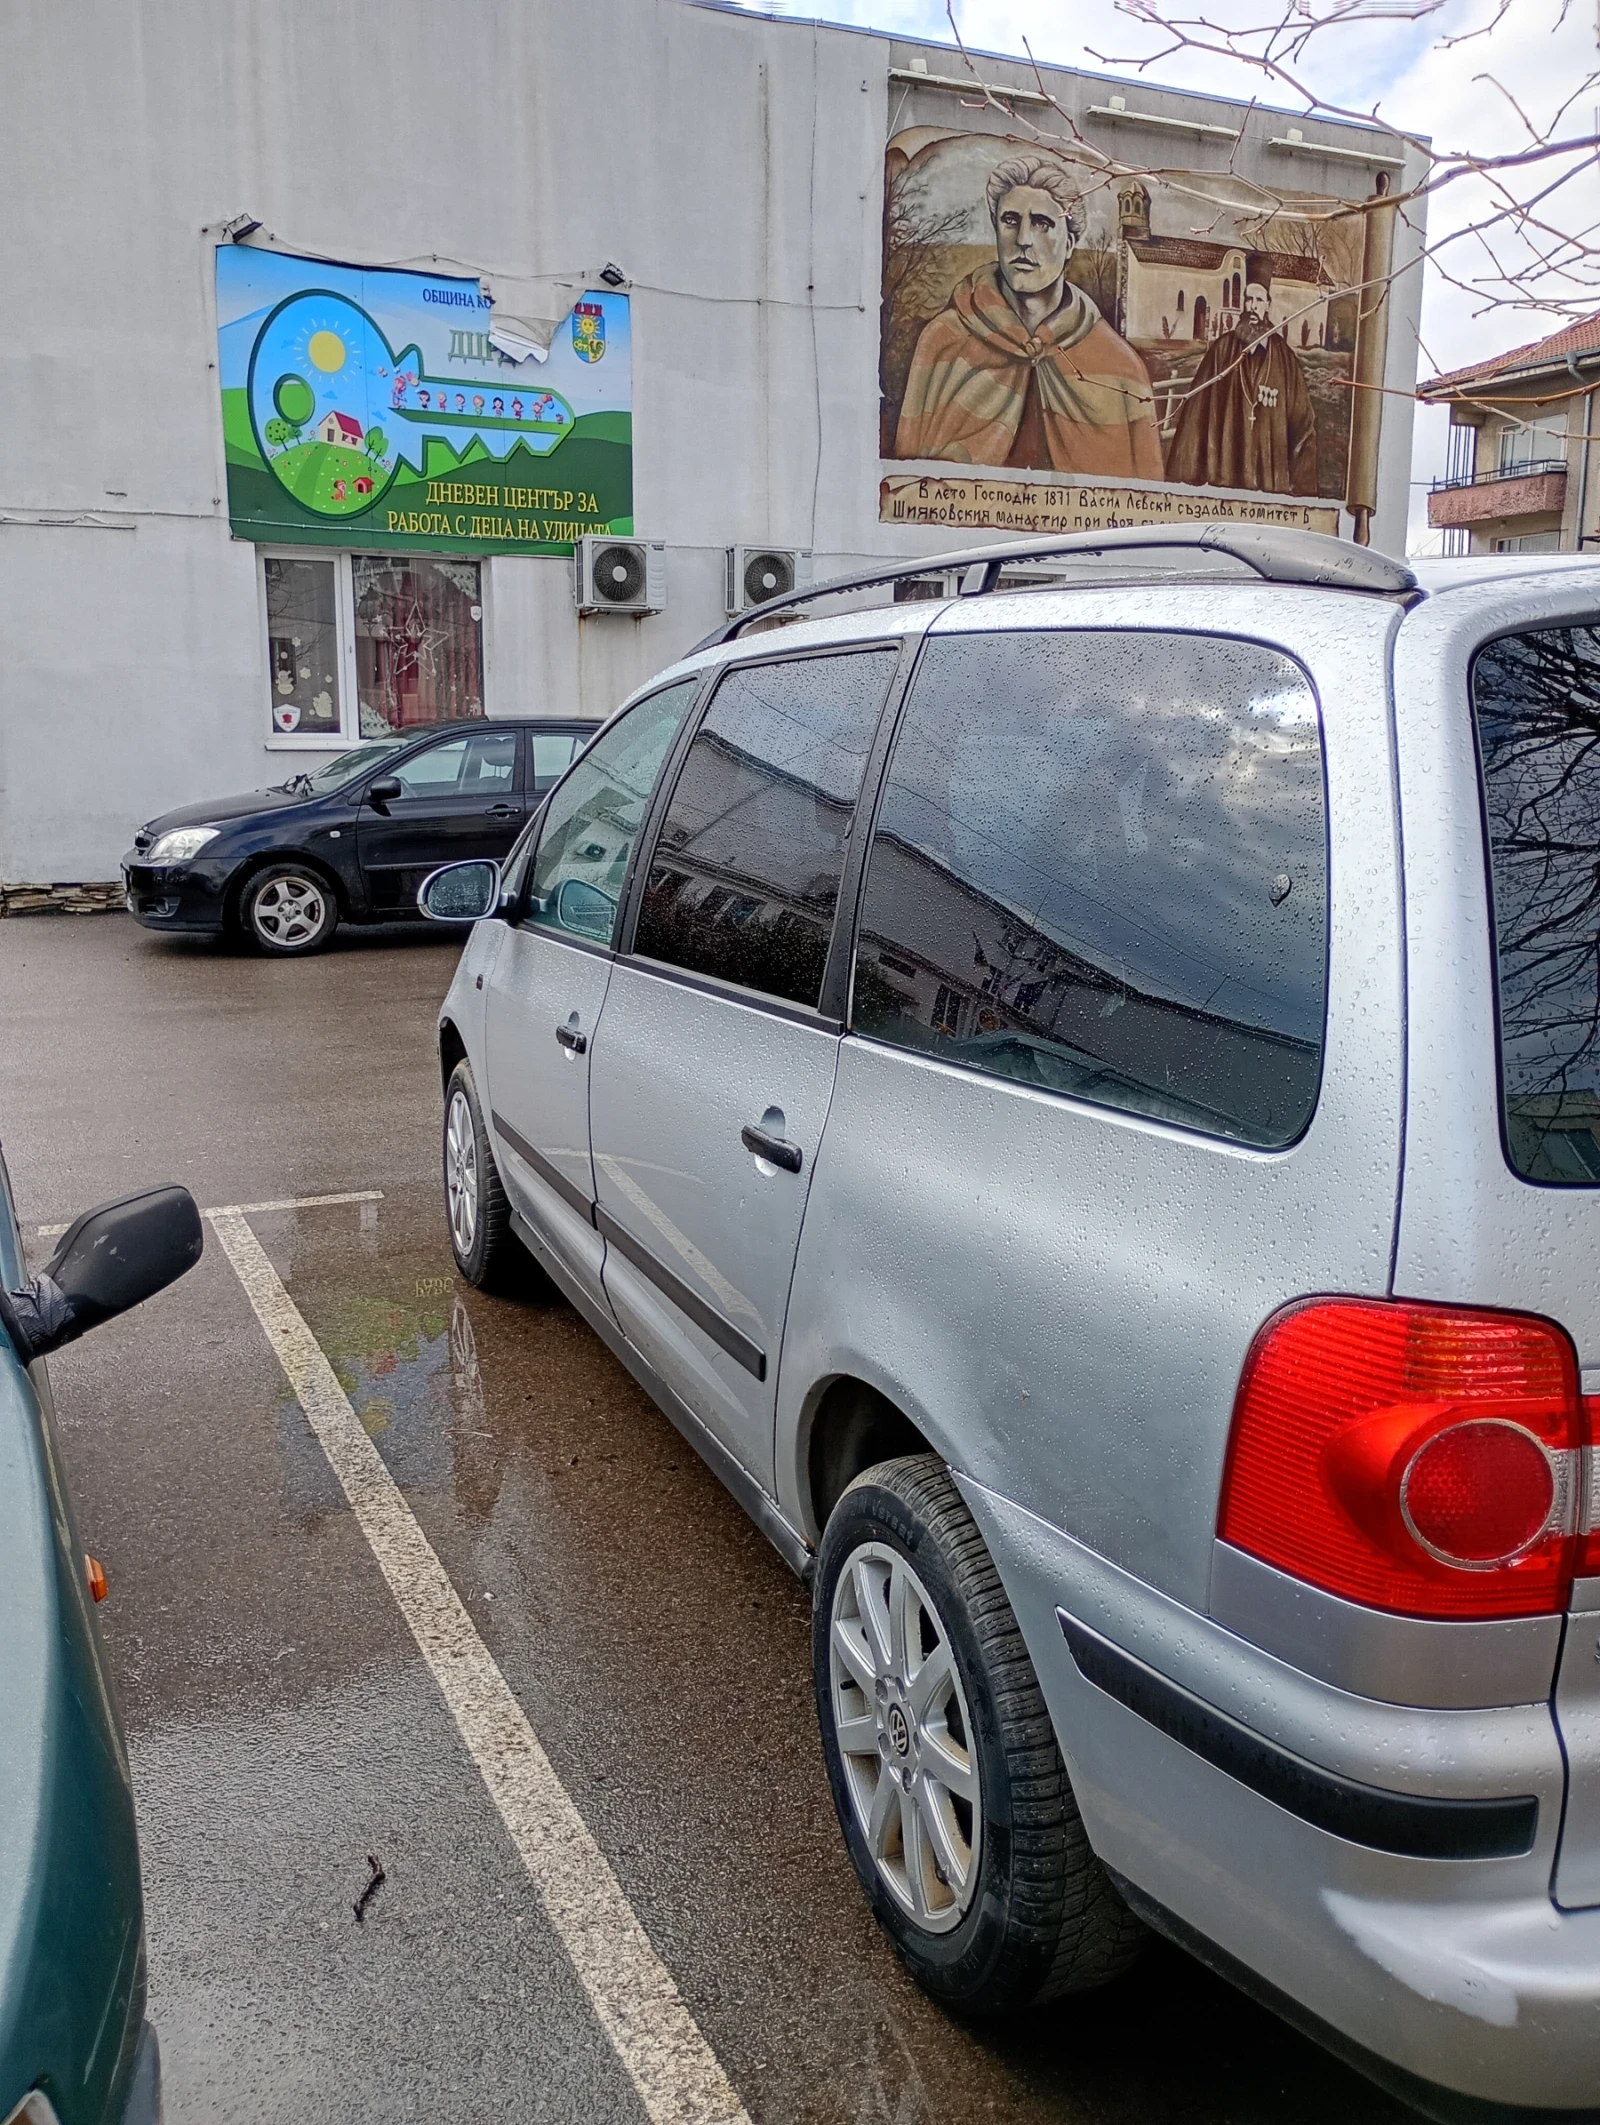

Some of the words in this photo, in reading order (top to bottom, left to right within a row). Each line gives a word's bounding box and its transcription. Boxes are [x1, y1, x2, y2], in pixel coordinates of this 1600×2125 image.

[422, 288, 475, 309] ОБЩИНА
[425, 481, 500, 507] ДНЕВЕН
[503, 486, 574, 511] ЦЕНТЪР
[577, 492, 600, 513] ЗА
[974, 484, 1038, 506] Господне
[1044, 489, 1071, 506] 1871
[1079, 489, 1121, 509] Васил
[1126, 492, 1173, 513] Левски
[1177, 500, 1235, 519] създава
[1239, 506, 1298, 522] комитет
[387, 510, 452, 535] РАБОТА
[469, 516, 517, 542] ДЕЦА
[517, 518, 541, 540] НА
[893, 499, 990, 523] Шияковския
[995, 510, 1068, 532] манастир
[1074, 515, 1101, 531] при
